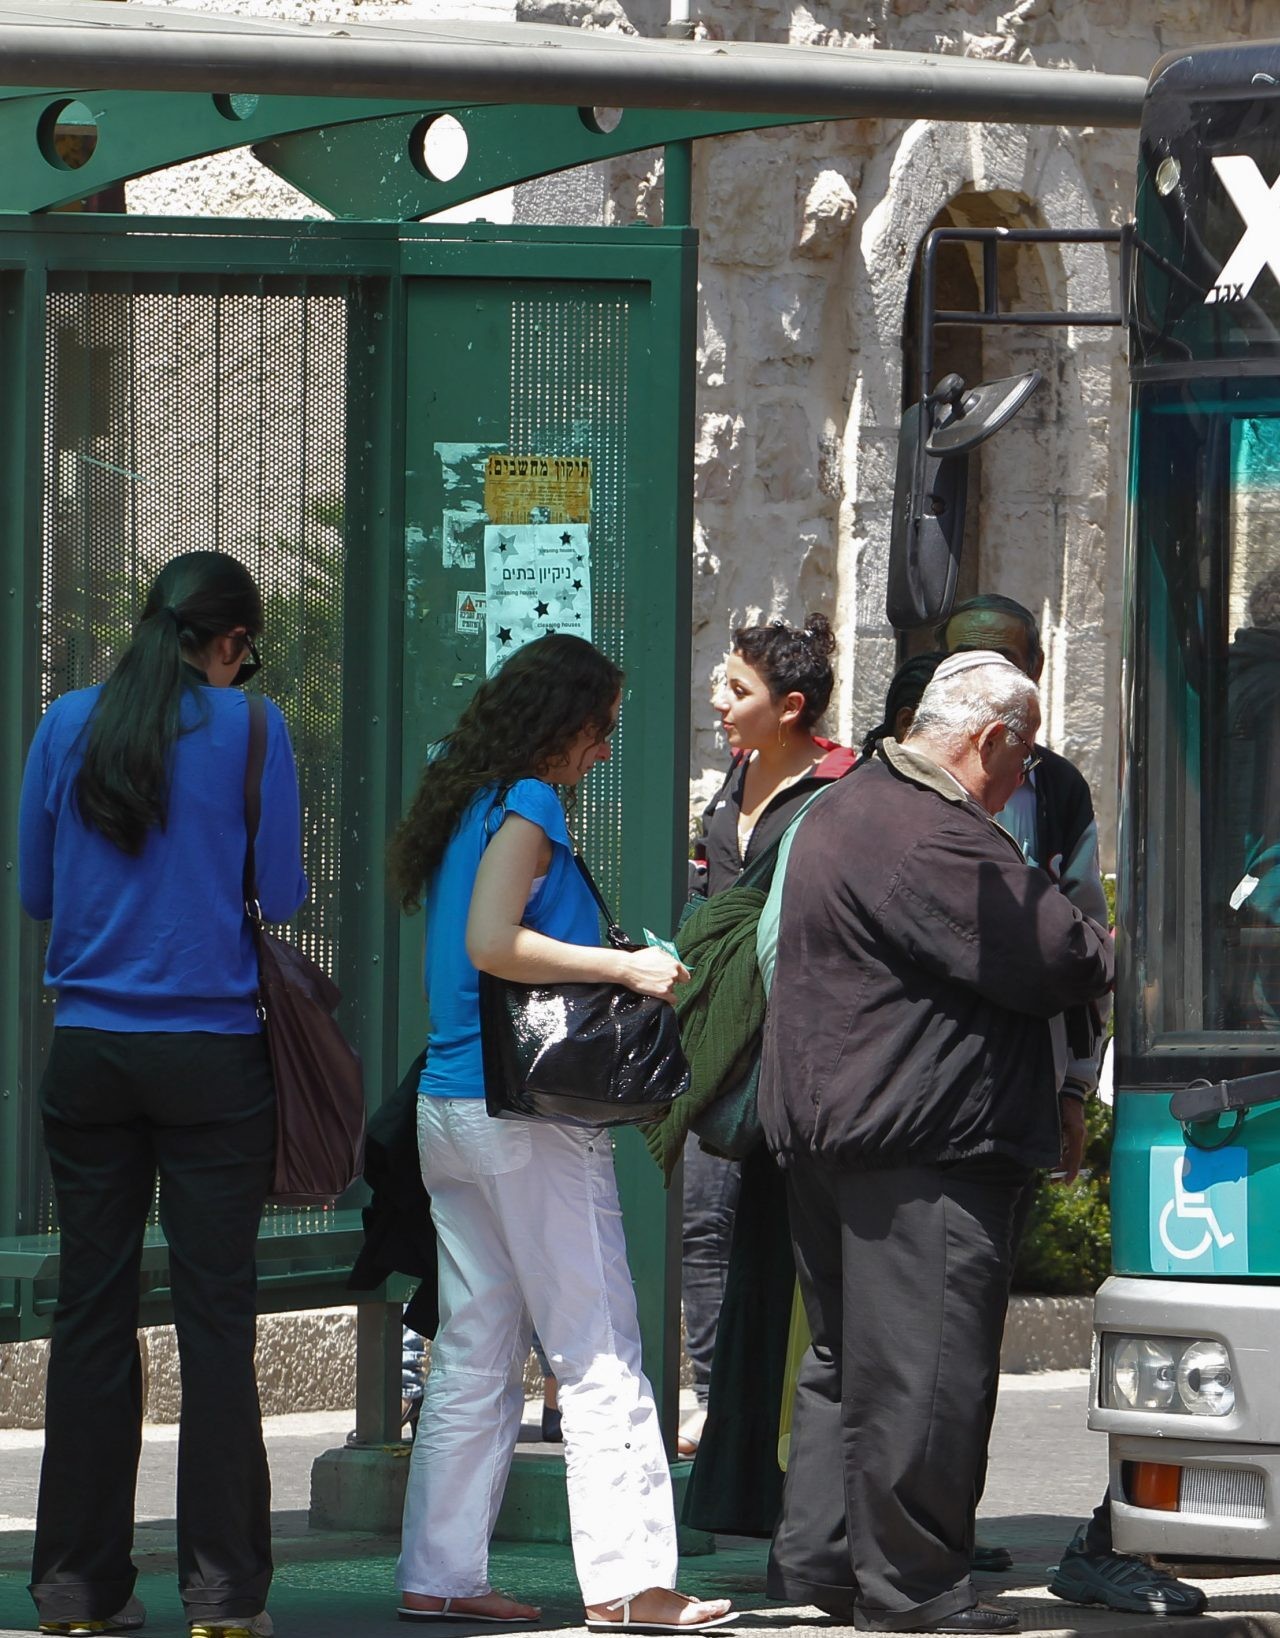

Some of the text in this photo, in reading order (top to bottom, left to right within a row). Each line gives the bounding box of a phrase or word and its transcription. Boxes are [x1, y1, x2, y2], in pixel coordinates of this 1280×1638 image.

[554, 460, 589, 481] תיקון
[502, 567, 571, 584] ניקיון בתים
